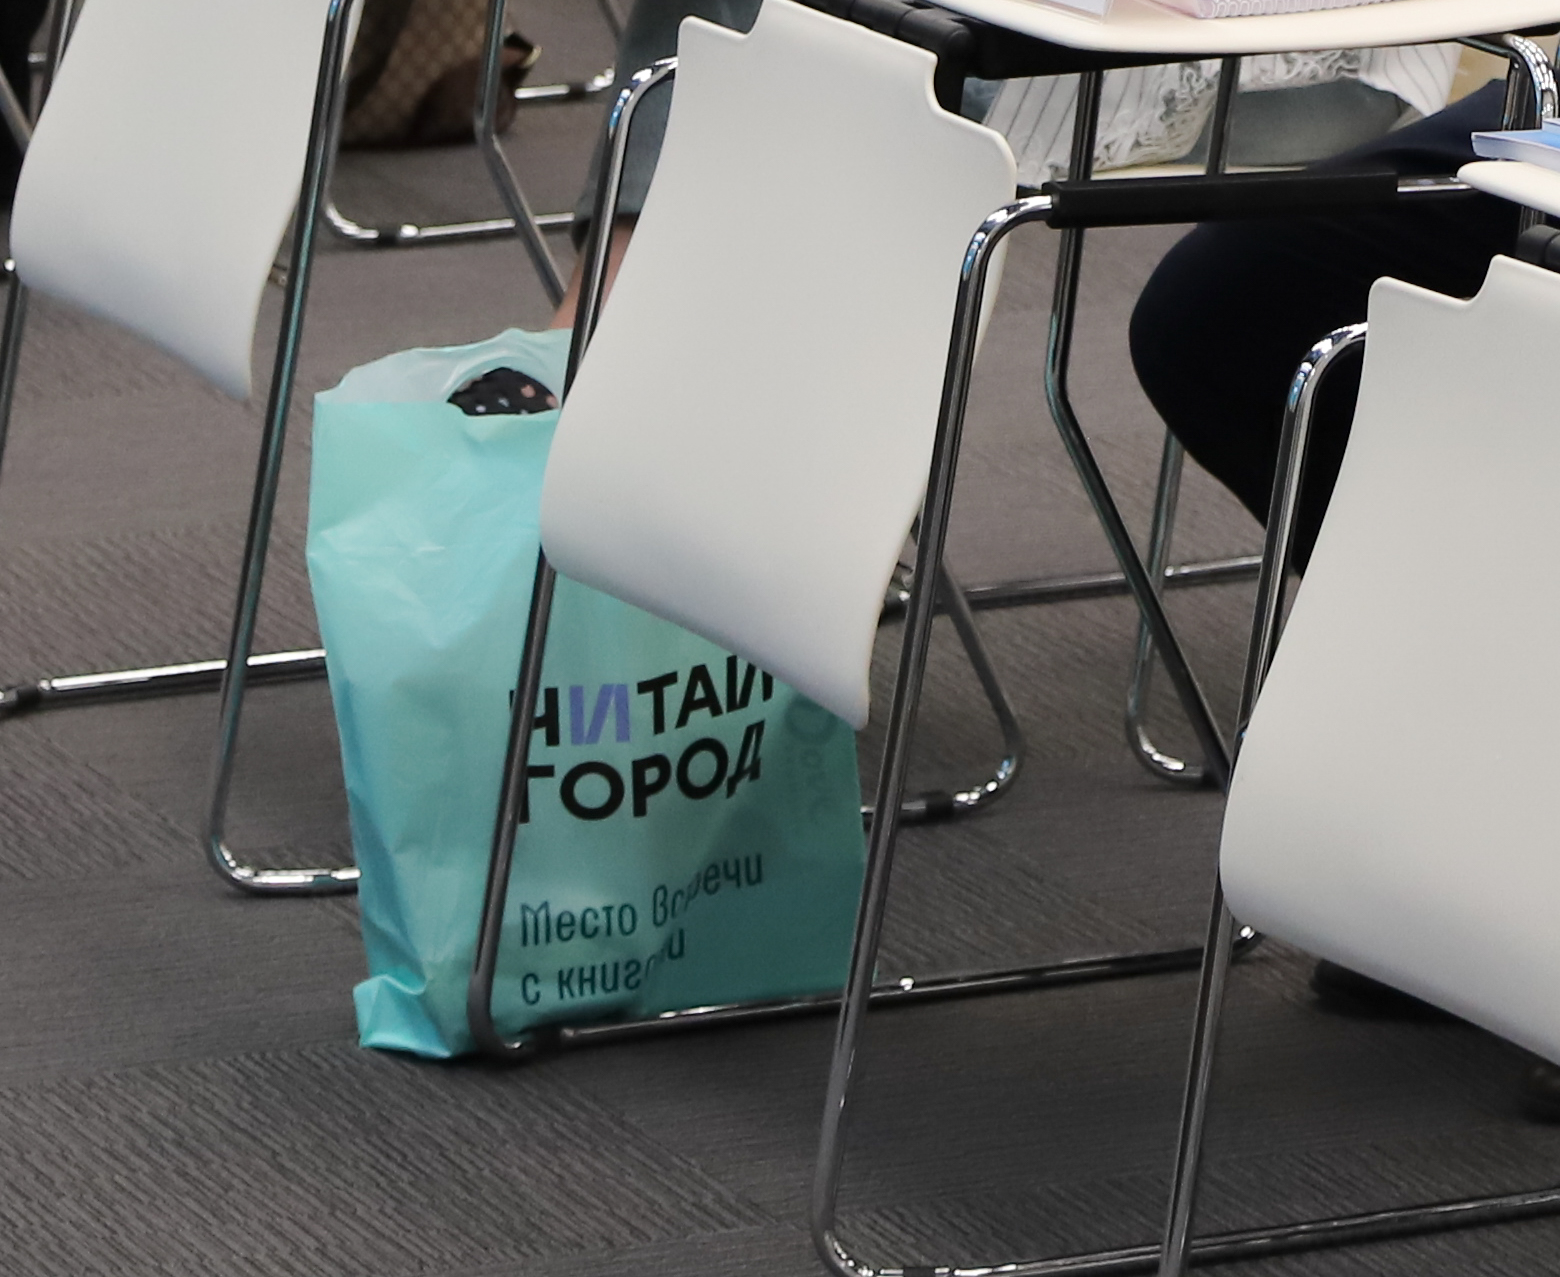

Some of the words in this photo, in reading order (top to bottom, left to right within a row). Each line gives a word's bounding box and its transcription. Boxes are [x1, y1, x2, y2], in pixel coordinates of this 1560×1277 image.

[519, 719, 766, 825] ГОРОД
[520, 900, 638, 948] Место
[521, 972, 542, 1006] с
